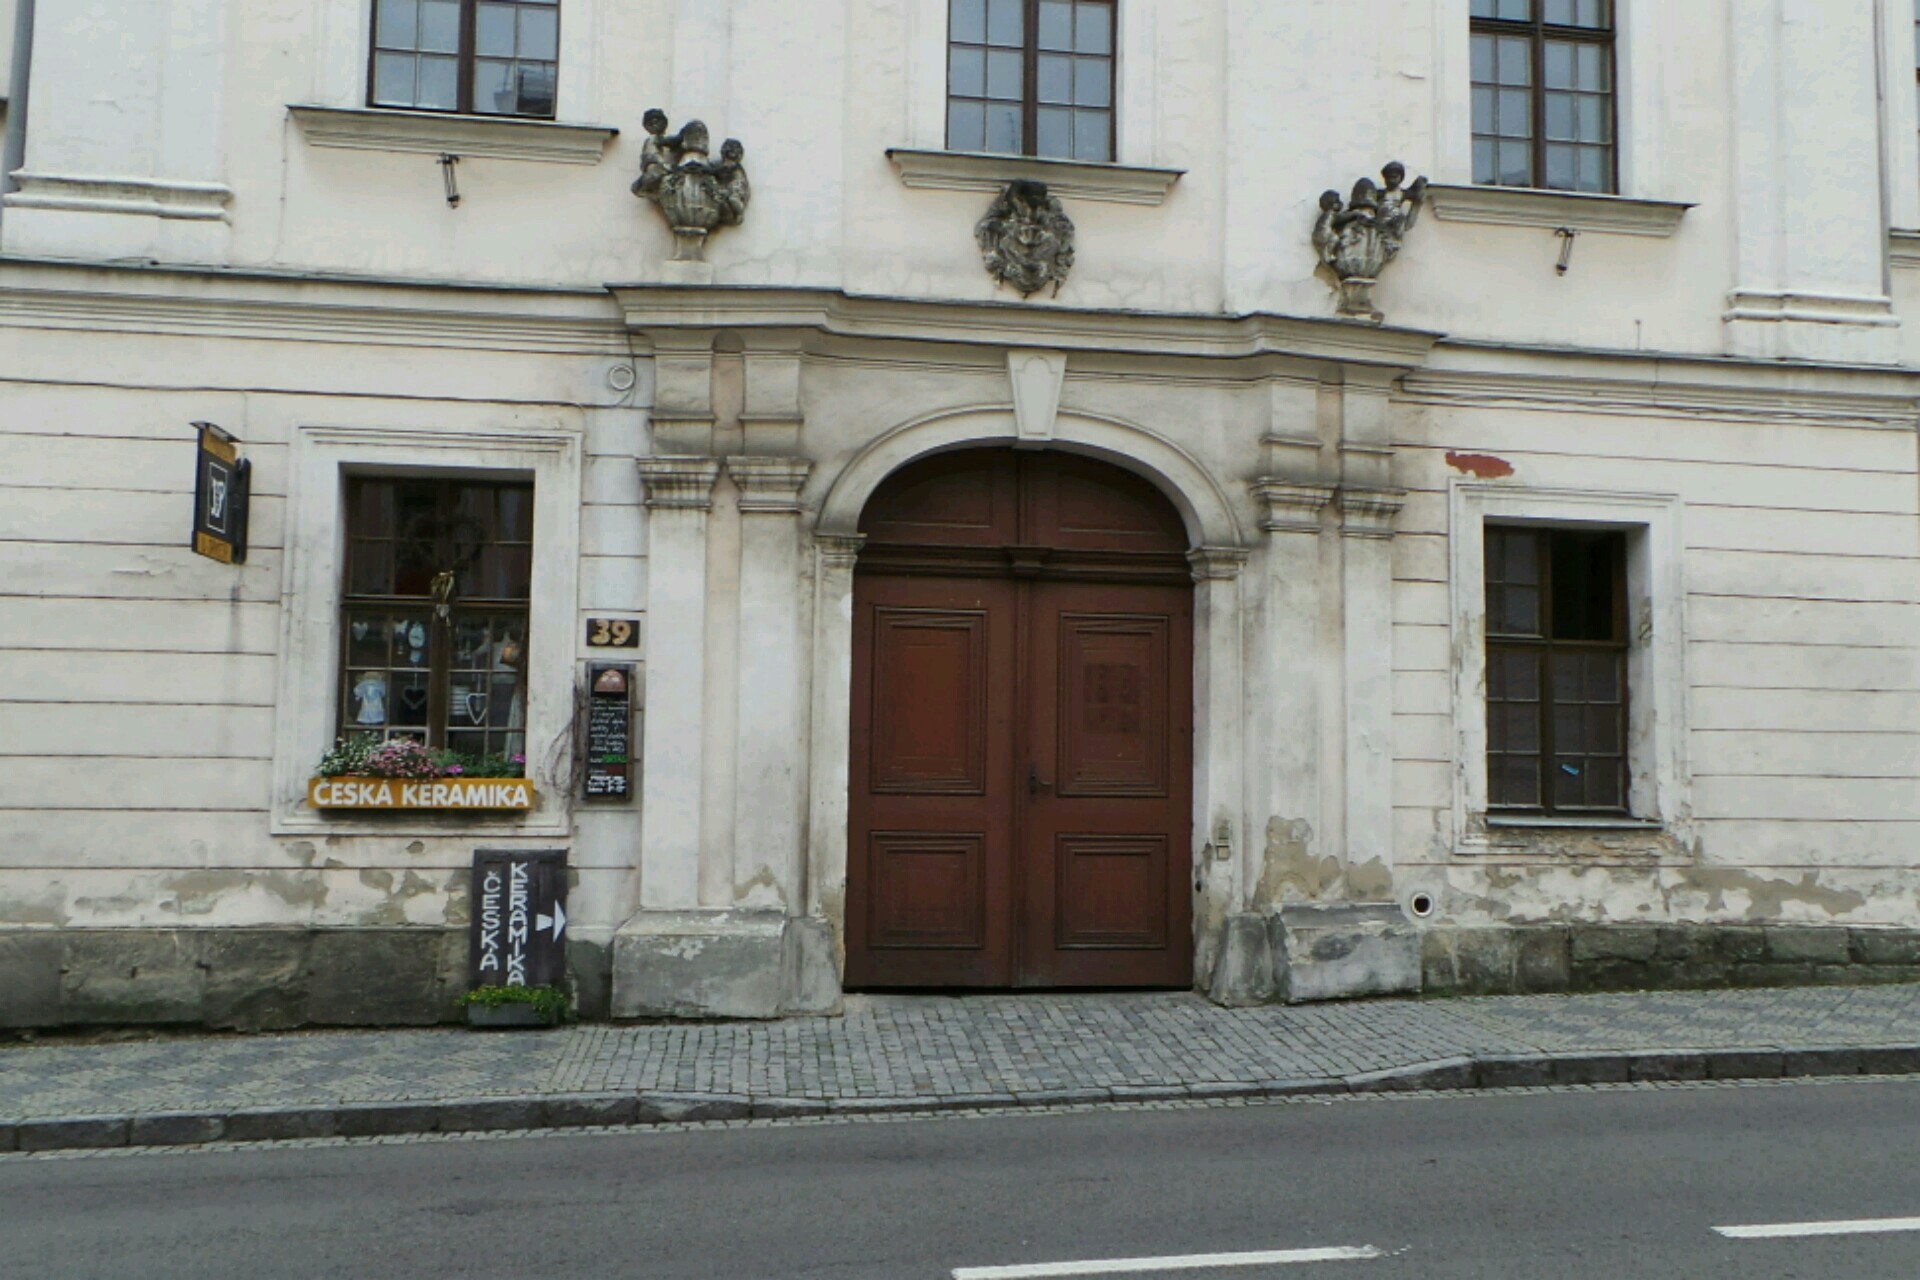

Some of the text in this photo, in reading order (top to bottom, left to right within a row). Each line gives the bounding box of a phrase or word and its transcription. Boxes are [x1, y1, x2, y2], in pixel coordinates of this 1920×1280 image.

[591, 618, 631, 645] 39
[313, 778, 529, 807] ČESKÁ KERAMIKA
[480, 862, 528, 986] ČESKÁ KERAMIKA
